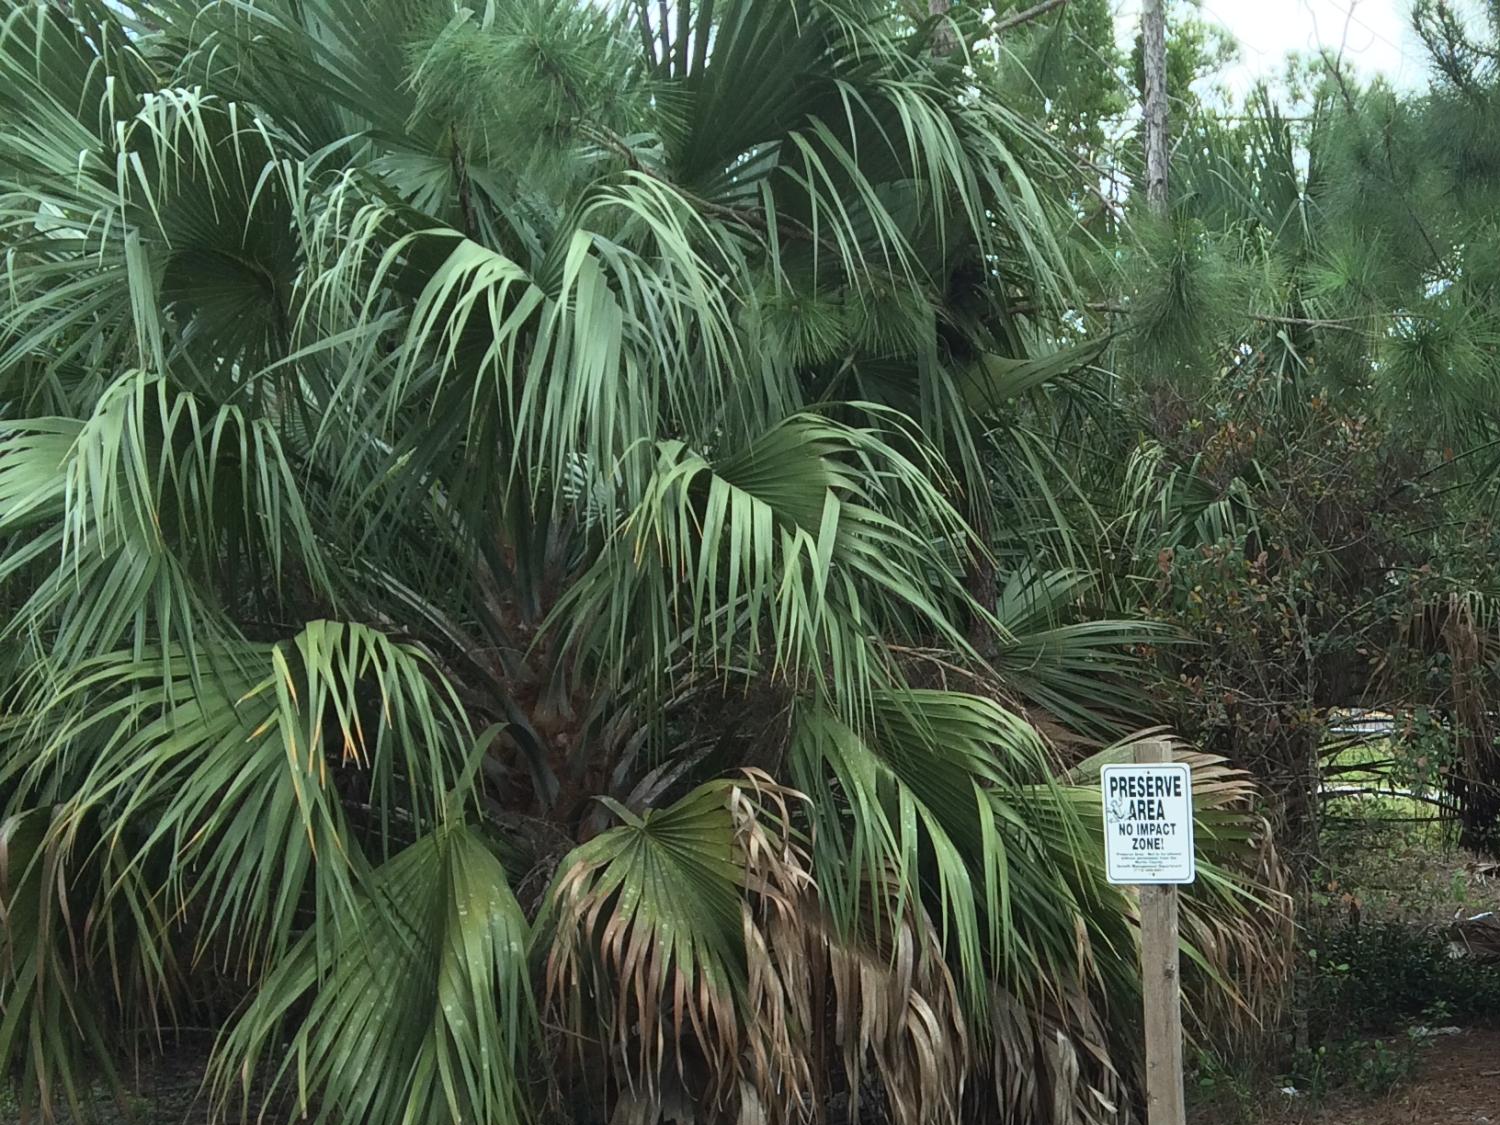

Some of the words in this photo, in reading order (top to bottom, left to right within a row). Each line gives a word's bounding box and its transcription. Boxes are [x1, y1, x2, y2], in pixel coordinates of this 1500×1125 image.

[1110, 776, 1182, 798] PRESERVE
[1128, 799, 1166, 820] AREA
[1119, 823, 1133, 836] NO
[1137, 823, 1176, 836] IMPACT
[1132, 838, 1164, 850] ZONE!
